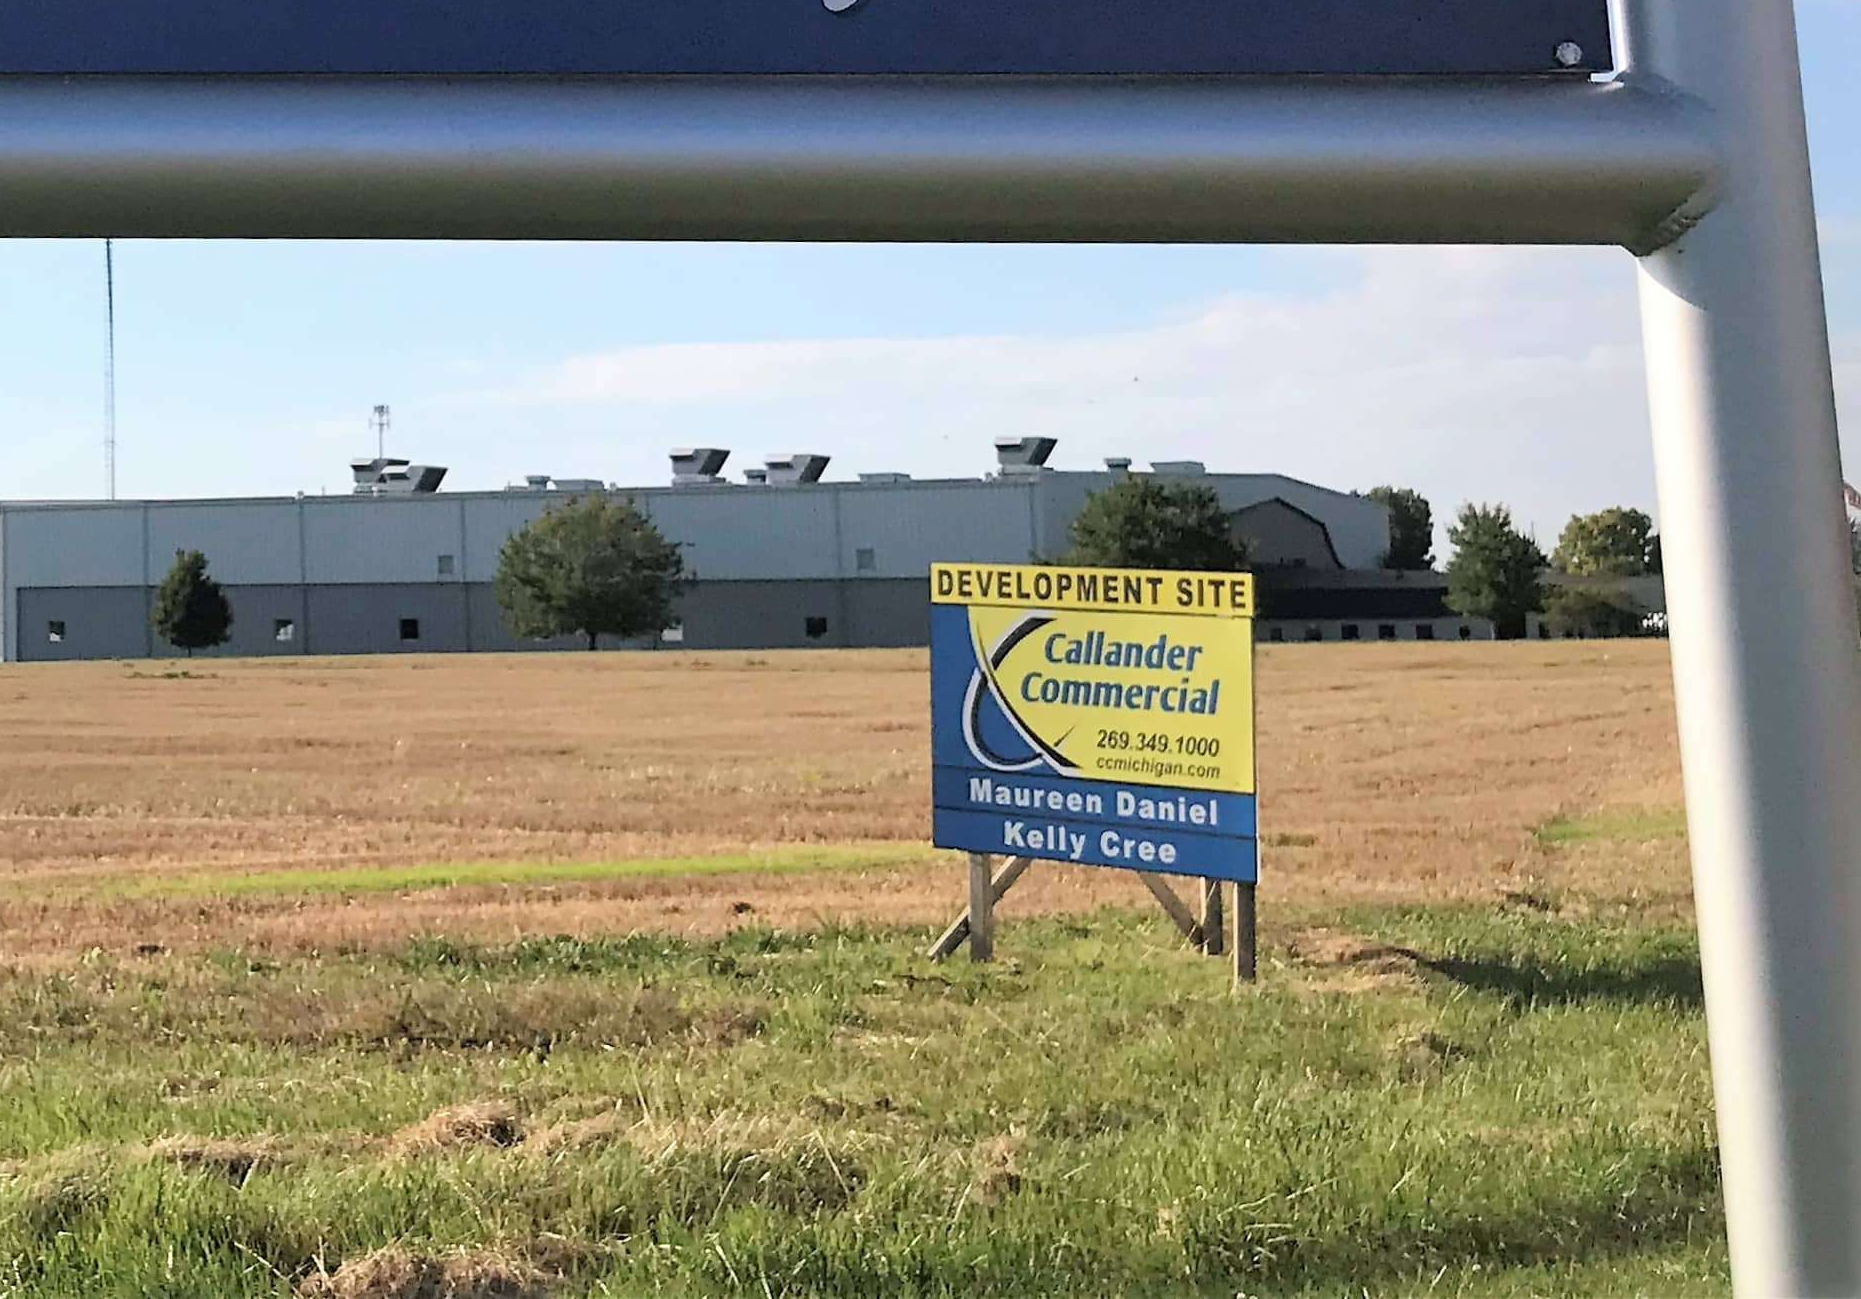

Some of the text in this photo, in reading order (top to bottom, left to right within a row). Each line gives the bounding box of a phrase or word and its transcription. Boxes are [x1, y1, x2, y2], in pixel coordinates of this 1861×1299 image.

[938, 569, 1247, 609] DEVELOPMENT SITE
[1044, 630, 1203, 672] Callander
[1020, 672, 1220, 715] Commercial
[1096, 729, 1220, 757] 269.349.1000
[1096, 756, 1221, 779] ccmichigan.com
[969, 778, 1218, 826] Maureen Daniel
[1003, 820, 1177, 864] Kelly Cree
